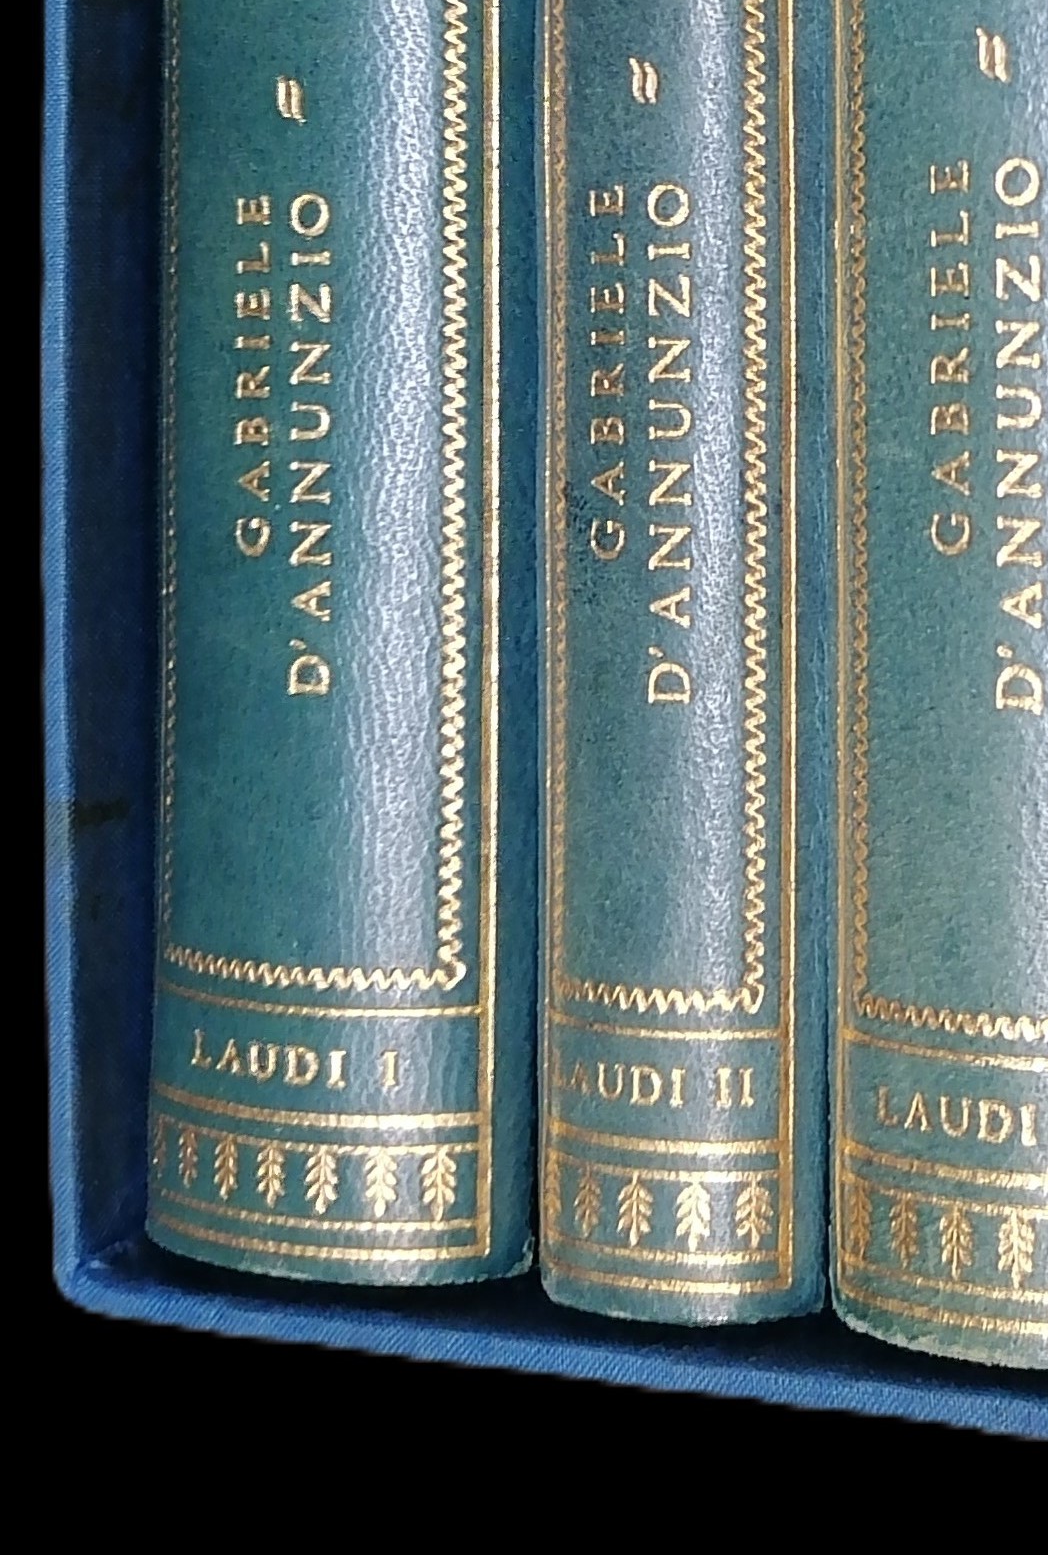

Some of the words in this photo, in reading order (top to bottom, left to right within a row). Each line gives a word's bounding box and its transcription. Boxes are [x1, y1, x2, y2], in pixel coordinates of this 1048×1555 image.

[235, 194, 272, 557] GABRIELE
[288, 193, 331, 697] D'ANNUNZIO
[589, 184, 625, 559] GABRIELE
[647, 183, 692, 706] D'ANNUNZIO
[930, 159, 971, 556] GABRIELE
[995, 156, 1045, 716] D'ANNUNZIO
[192, 1029, 347, 1089] LAUDI
[381, 1049, 398, 1088] I
[715, 1067, 756, 1107] II
[877, 1085, 1037, 1146] LAUDI
